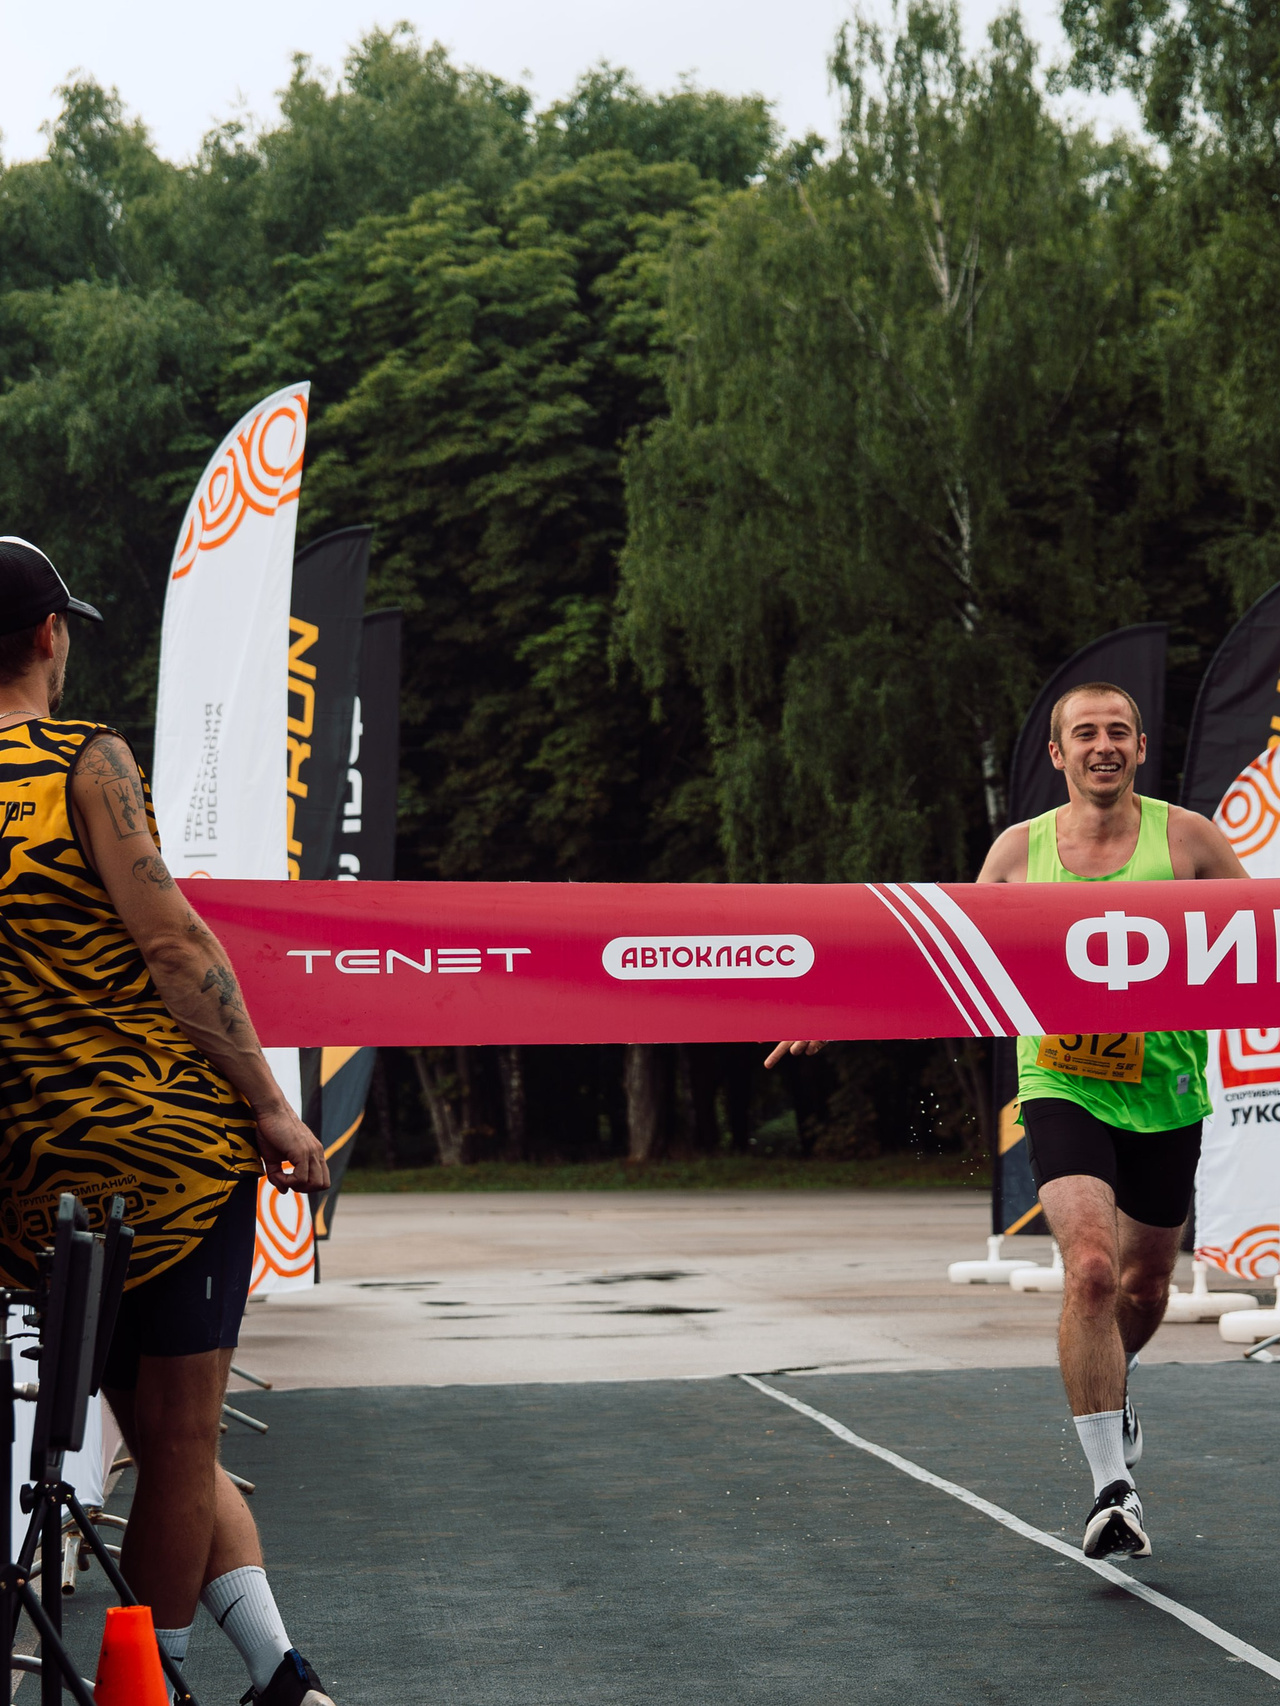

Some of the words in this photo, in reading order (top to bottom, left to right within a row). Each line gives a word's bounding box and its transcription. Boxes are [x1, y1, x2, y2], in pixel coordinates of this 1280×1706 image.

[0, 801, 36, 821] ОР
[286, 947, 532, 974] TENET
[621, 944, 796, 969] АВТОКЛАСС
[64, 1173, 138, 1196] ОМПАНИЙ
